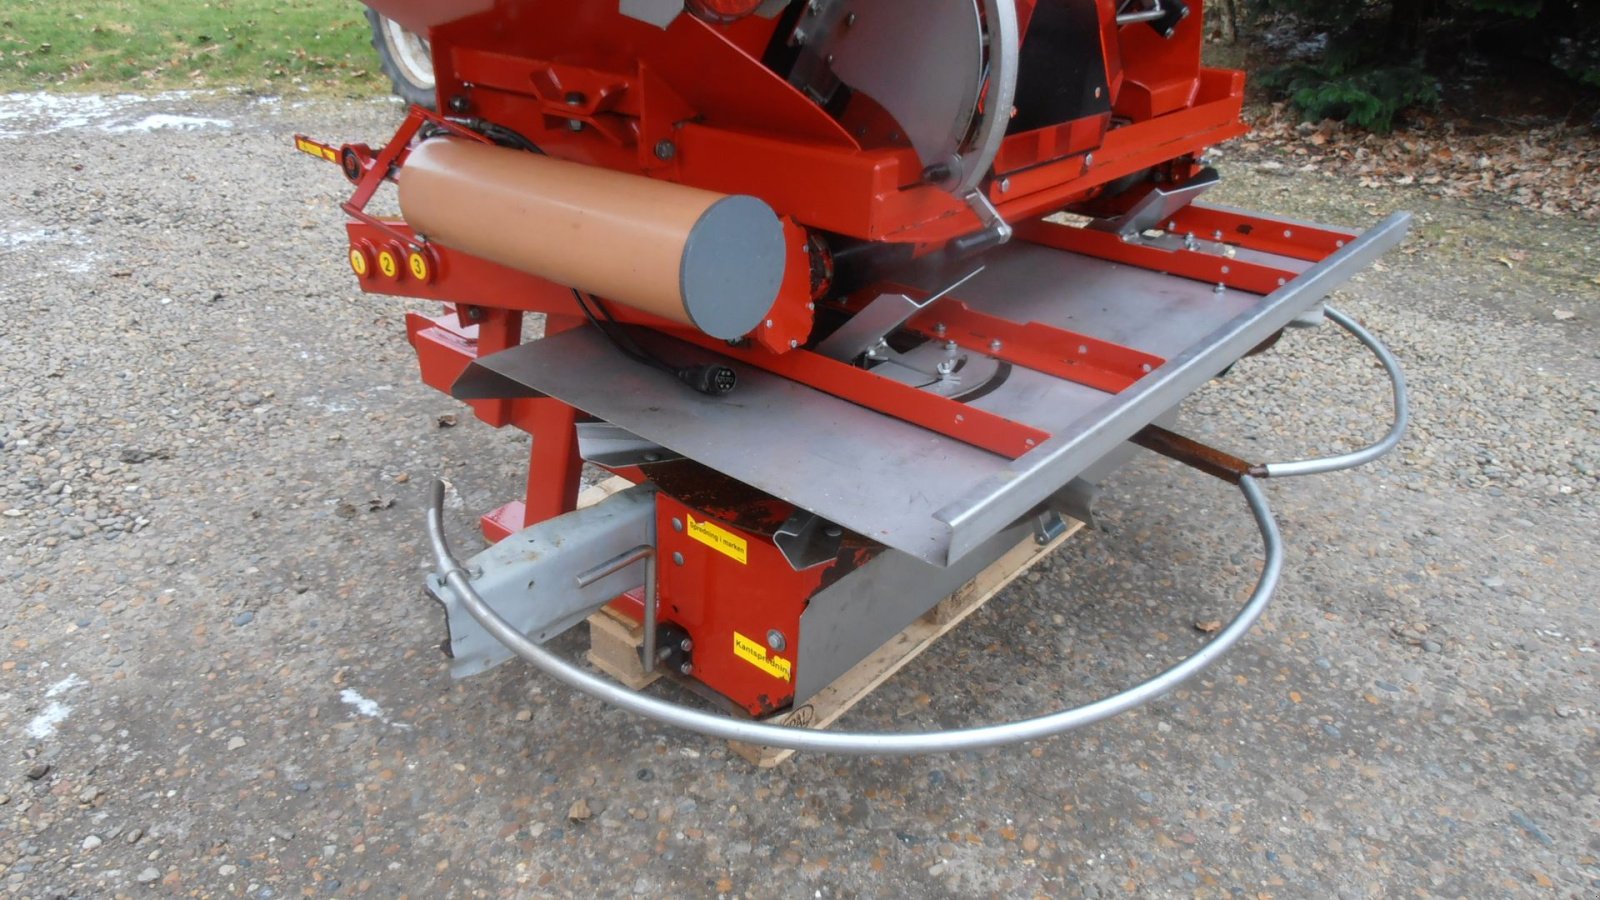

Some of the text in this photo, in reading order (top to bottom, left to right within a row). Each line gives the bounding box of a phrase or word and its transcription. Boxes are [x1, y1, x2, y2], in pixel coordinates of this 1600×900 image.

[355, 256, 362, 270] 1
[383, 257, 391, 272] 2
[414, 258, 422, 274] 3
[689, 521, 718, 542] Spredning
[723, 538, 745, 553] marken
[736, 639, 791, 677] Kantsprdnin
